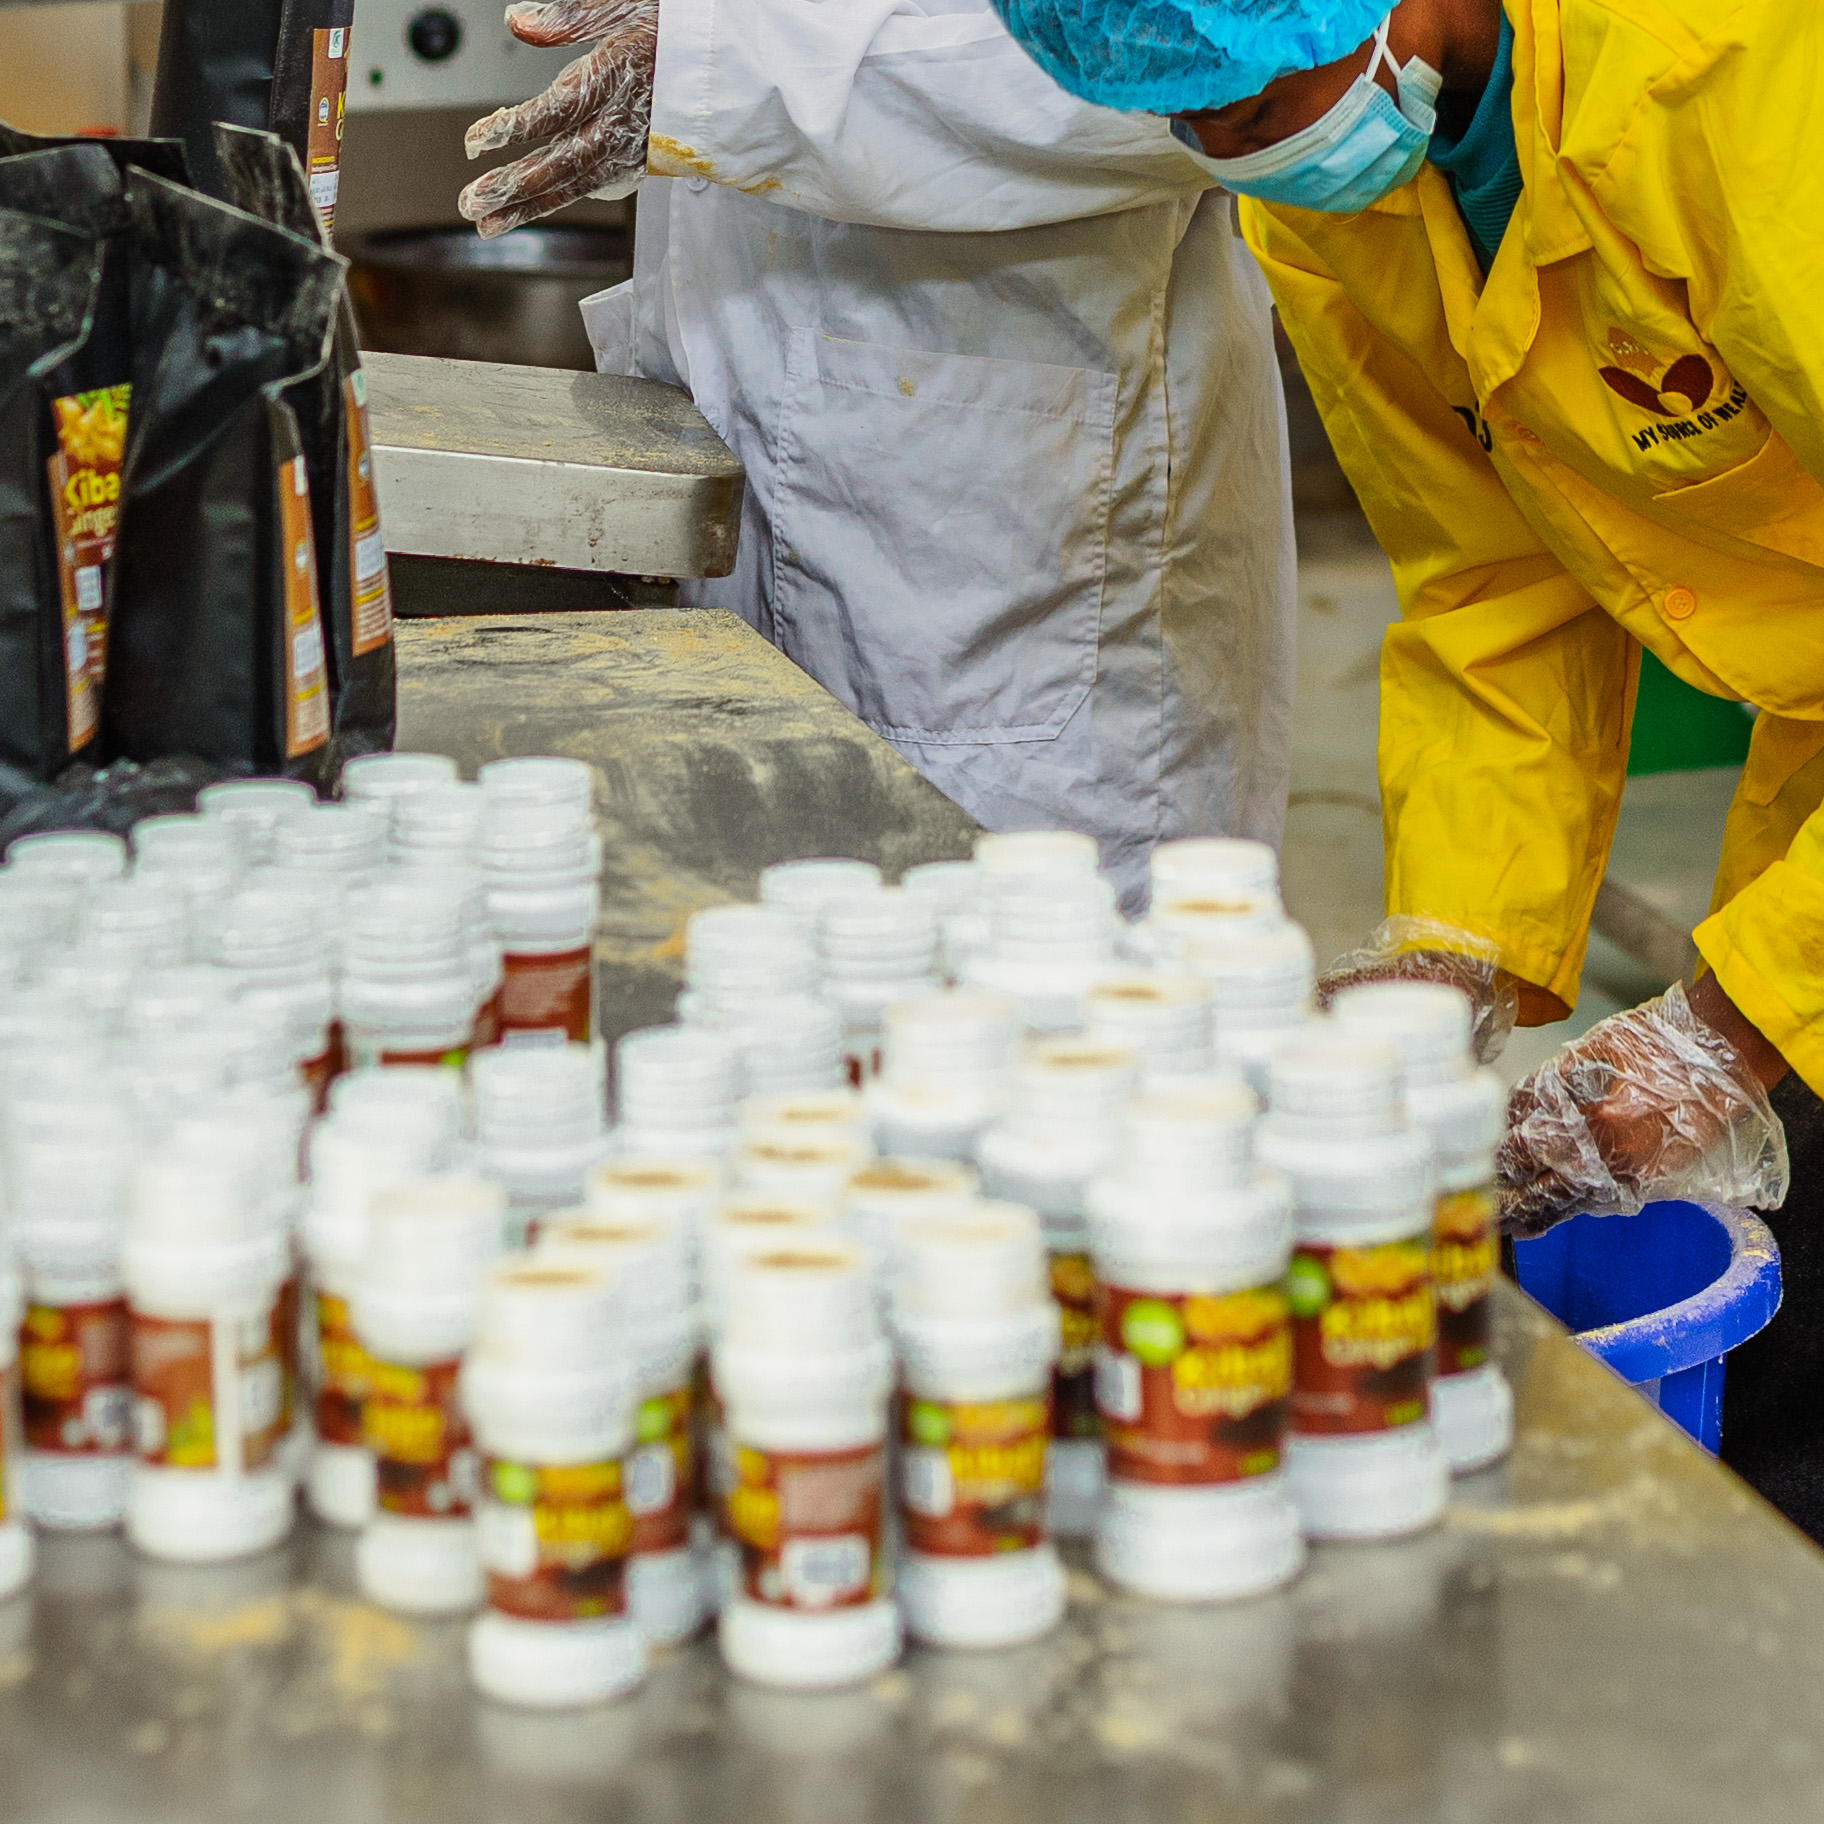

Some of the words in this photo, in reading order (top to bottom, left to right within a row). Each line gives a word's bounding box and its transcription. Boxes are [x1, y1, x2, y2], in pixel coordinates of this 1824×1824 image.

[1632, 426, 1660, 452] MY
[1656, 420, 1703, 442] SOURCE
[1697, 412, 1719, 430] OF
[1711, 379, 1748, 422] WEAL
